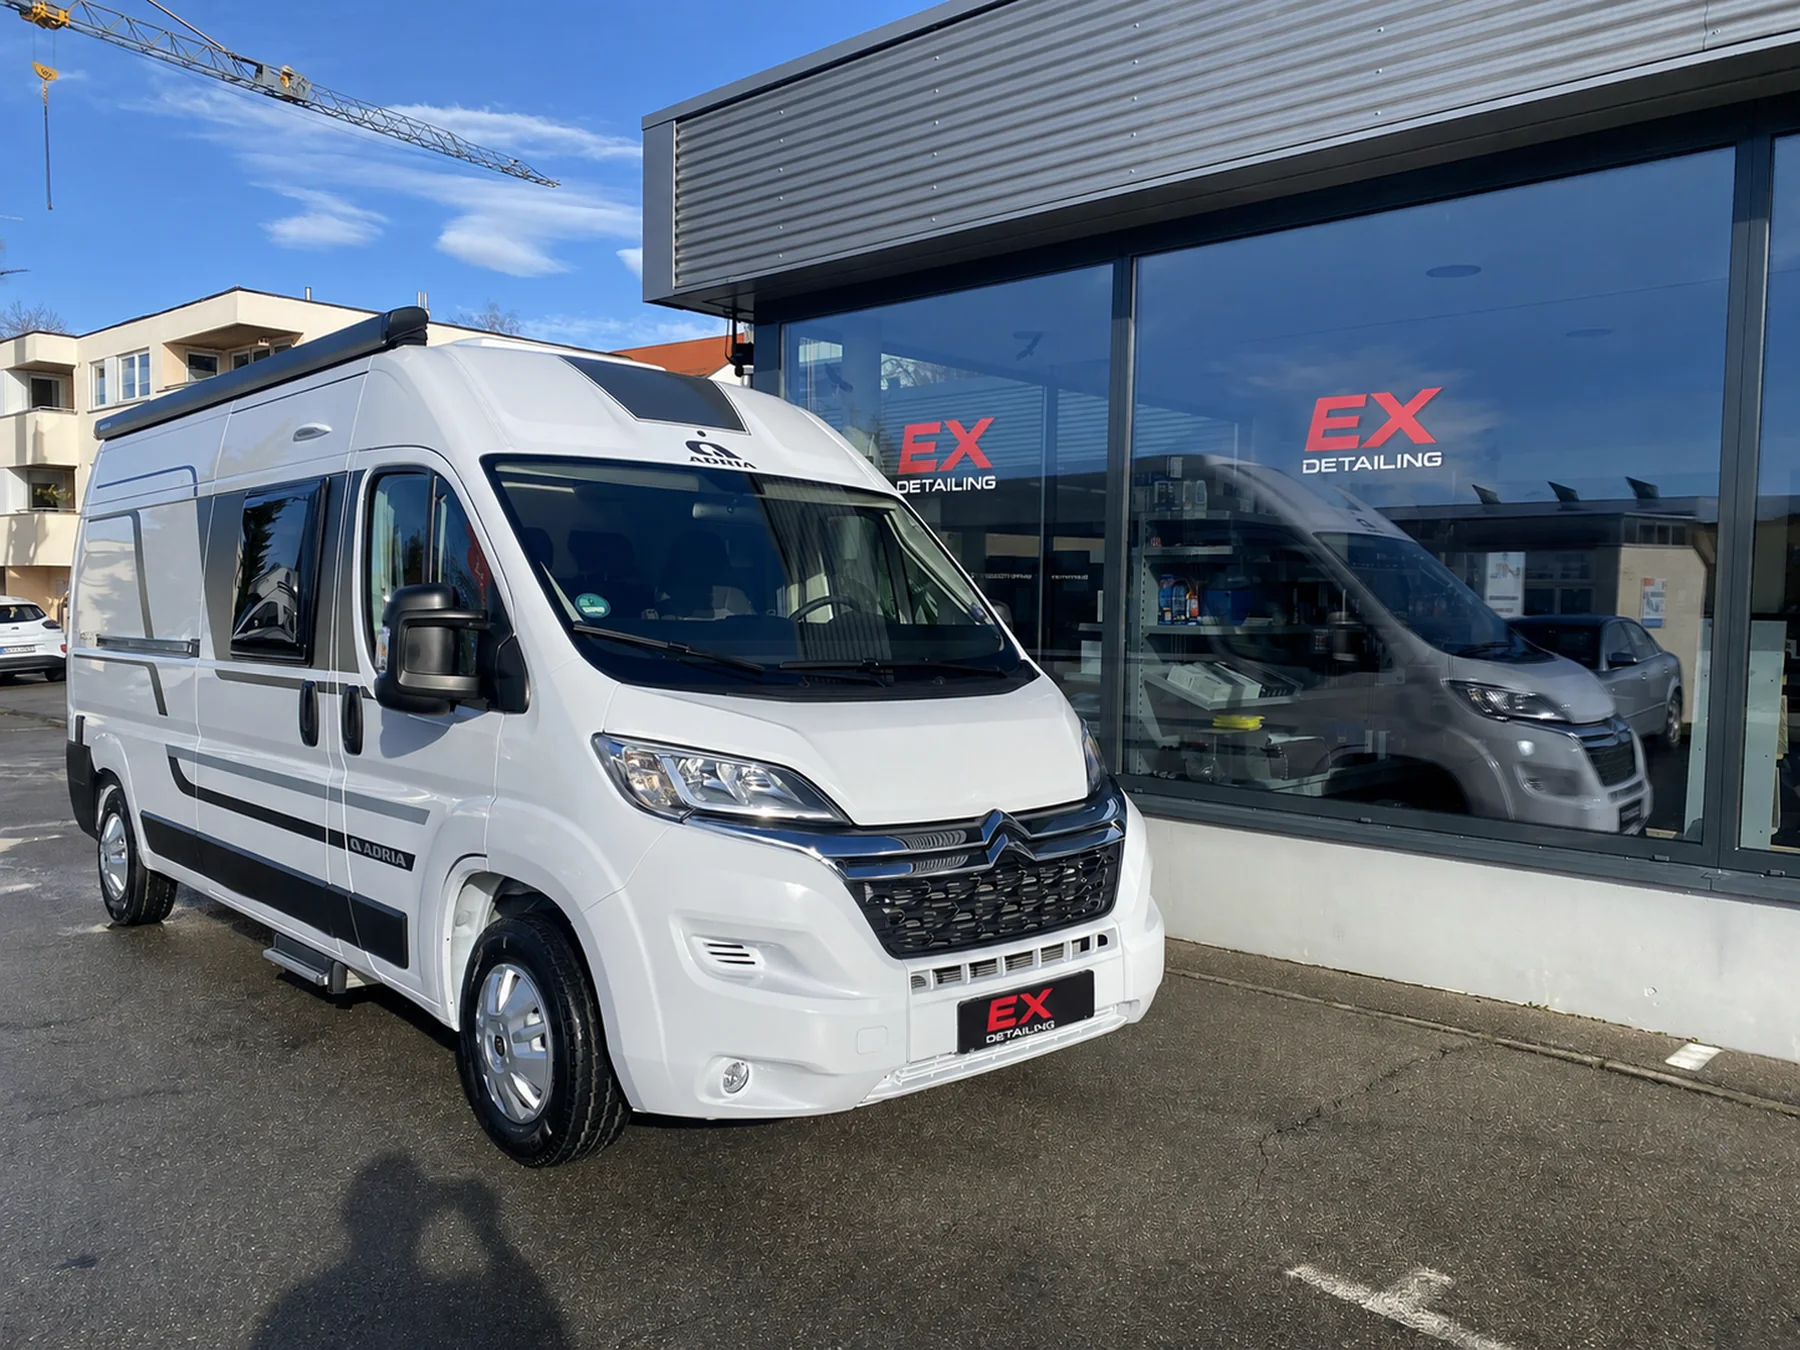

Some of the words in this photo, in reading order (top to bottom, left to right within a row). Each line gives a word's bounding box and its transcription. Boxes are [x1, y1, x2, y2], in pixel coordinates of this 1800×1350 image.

[1304, 387, 1442, 452] EX
[897, 416, 995, 475] EX
[689, 456, 757, 469] ADRIA
[1302, 452, 1443, 474] DETAILING
[896, 475, 997, 494] DETAILING
[363, 843, 407, 868] ADRIA
[986, 987, 1053, 1032] EX
[986, 1020, 1055, 1044] DETAILING
